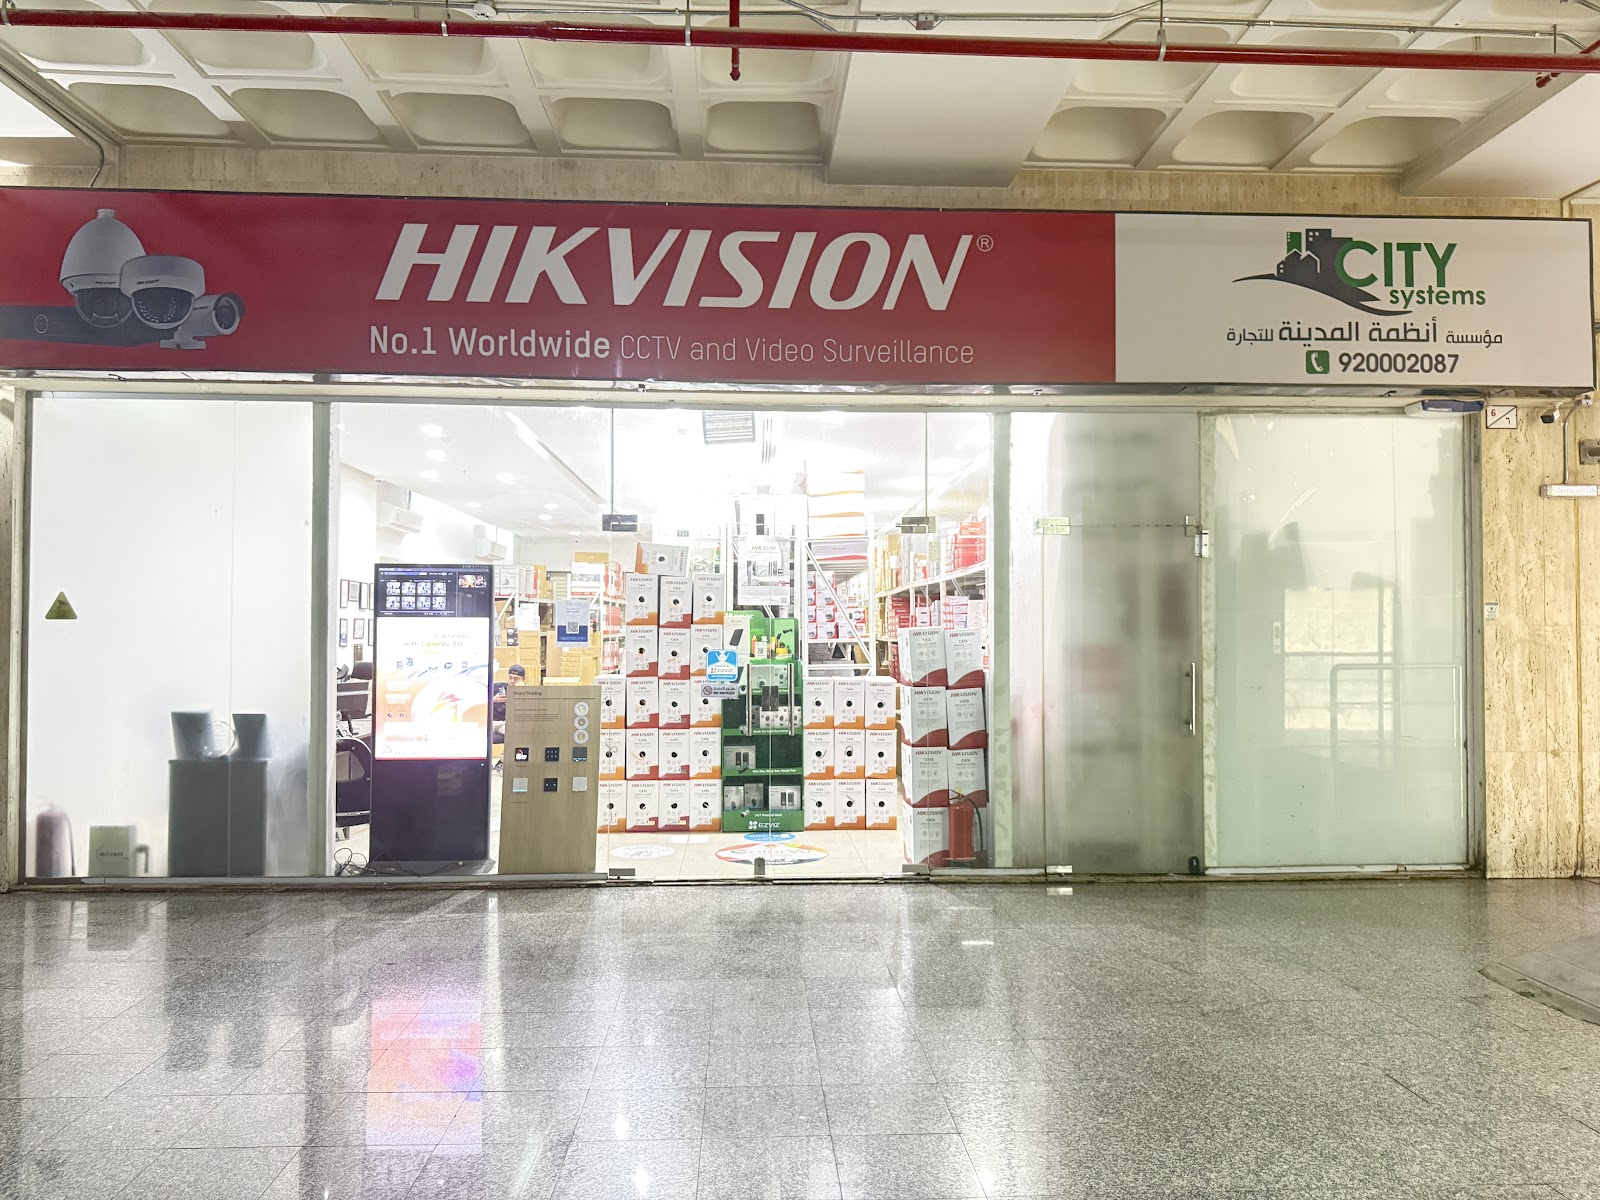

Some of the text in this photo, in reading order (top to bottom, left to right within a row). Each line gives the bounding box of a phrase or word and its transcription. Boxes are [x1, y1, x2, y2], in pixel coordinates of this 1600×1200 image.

[1334, 240, 1458, 288] CITY
[1388, 285, 1486, 309] systems
[370, 325, 974, 363] No.1 Worldwide CCTV and Video Surveillance
[1226, 316, 1503, 349] مؤسسة أنظمة المدينة للتجارة
[1338, 352, 1459, 374] 920002087
[1490, 408, 1497, 418] 6
